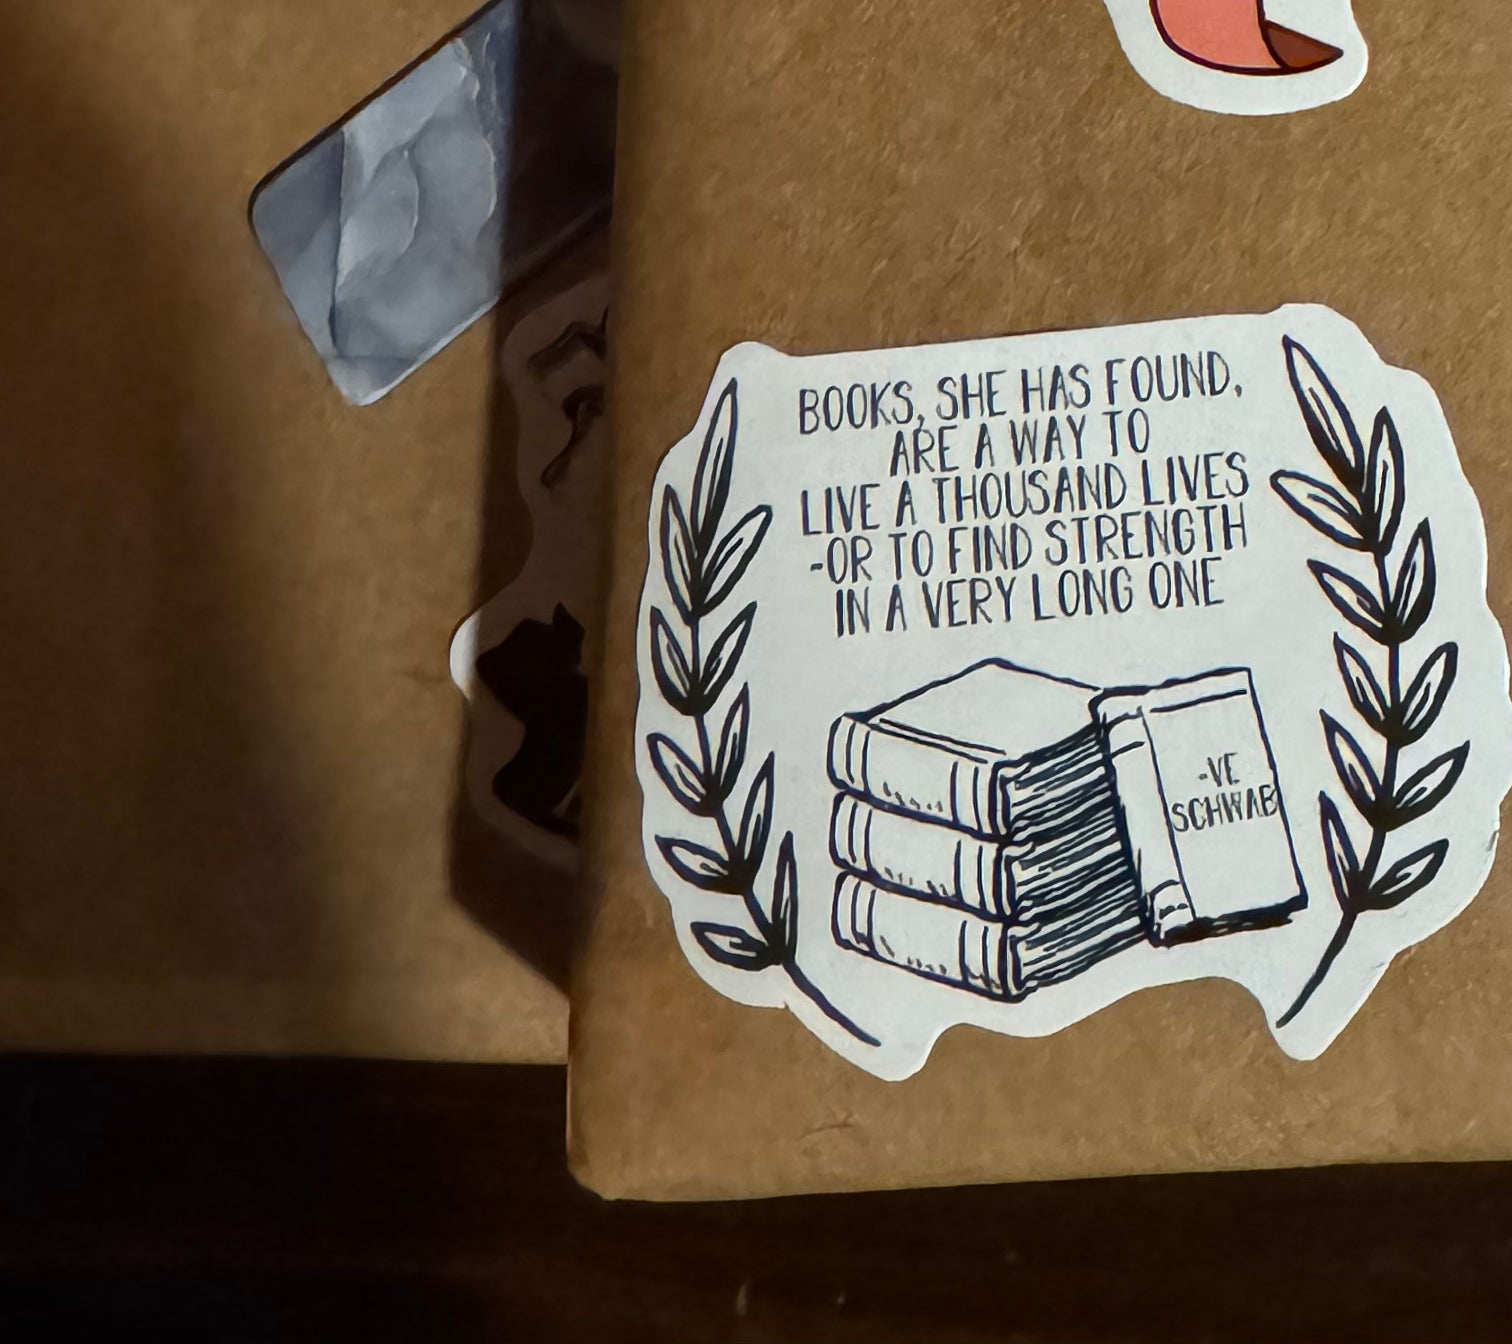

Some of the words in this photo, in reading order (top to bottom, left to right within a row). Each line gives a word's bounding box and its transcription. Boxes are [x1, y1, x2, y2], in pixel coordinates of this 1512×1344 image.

[799, 380, 926, 435] BOOKS,
[936, 370, 1008, 420] SHE
[1020, 363, 1091, 414] HAS
[890, 425, 959, 477] ARE
[974, 422, 995, 470] A
[1009, 414, 1086, 466] WAY
[1102, 408, 1150, 457] TO
[801, 483, 881, 536] LIVE
[895, 480, 918, 527] A
[932, 462, 1128, 525] THOUSAND
[1141, 451, 1249, 506] LIVES
[888, 529, 934, 581] TO
[949, 522, 1033, 574] FIND
[1045, 502, 1248, 566] STRENGTH
[835, 586, 871, 638] IN
[885, 584, 908, 632] A
[922, 575, 1017, 628] VERY
[1032, 566, 1134, 621] LONG
[1149, 557, 1225, 610] ONE
[1171, 784, 1280, 832] SCHWAB
